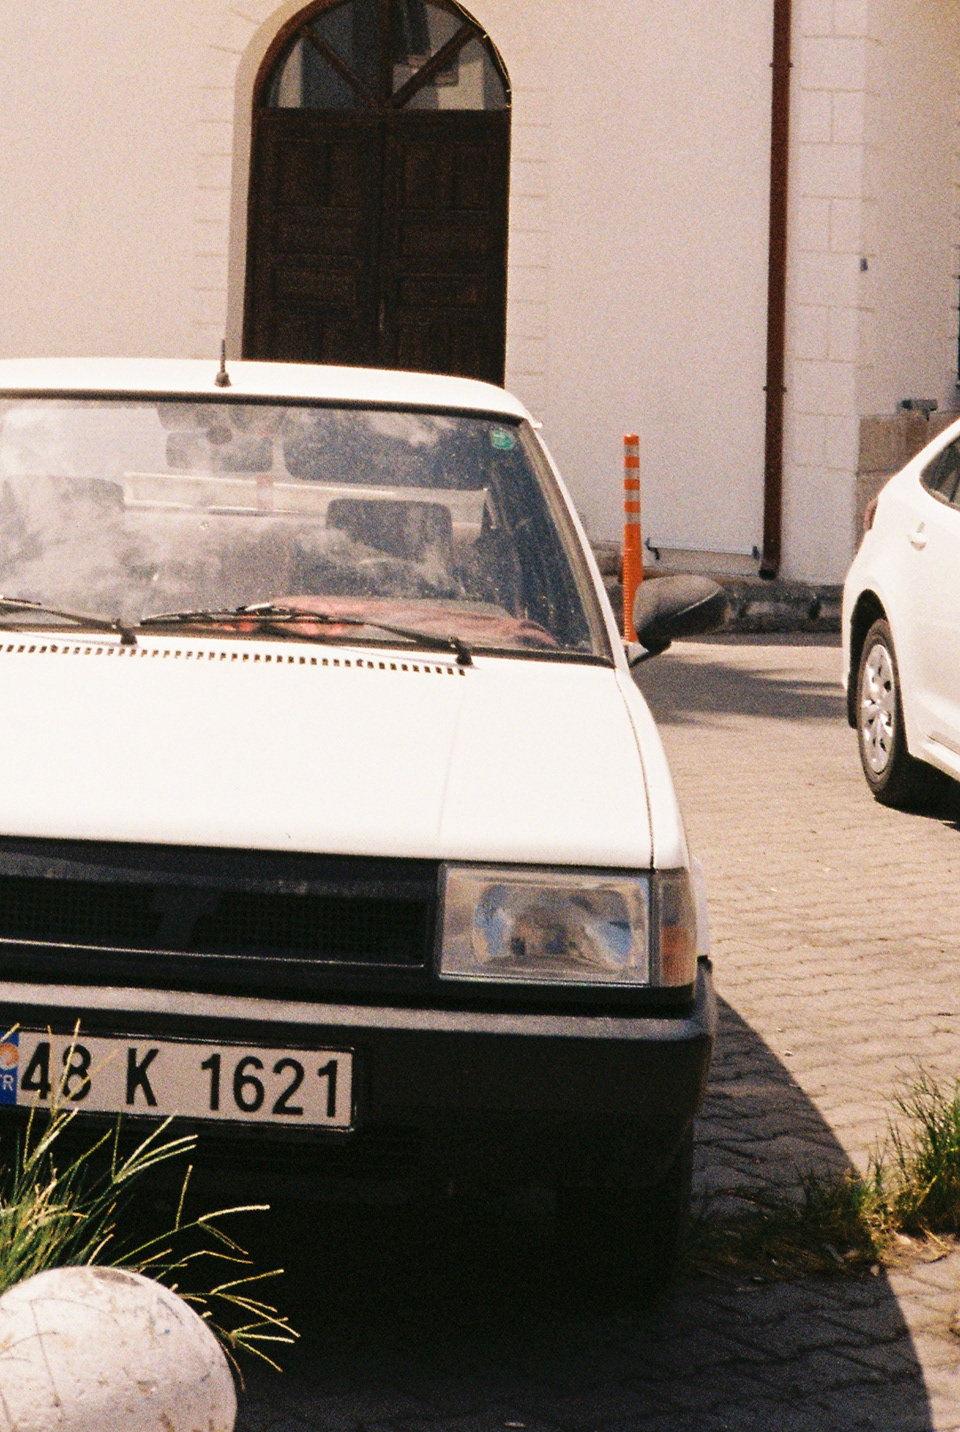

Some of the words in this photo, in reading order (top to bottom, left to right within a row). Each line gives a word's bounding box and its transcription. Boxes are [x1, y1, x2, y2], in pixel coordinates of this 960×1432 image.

[20, 1042, 92, 1102] 48
[125, 1047, 160, 1107] K
[200, 1053, 339, 1118] 1621
